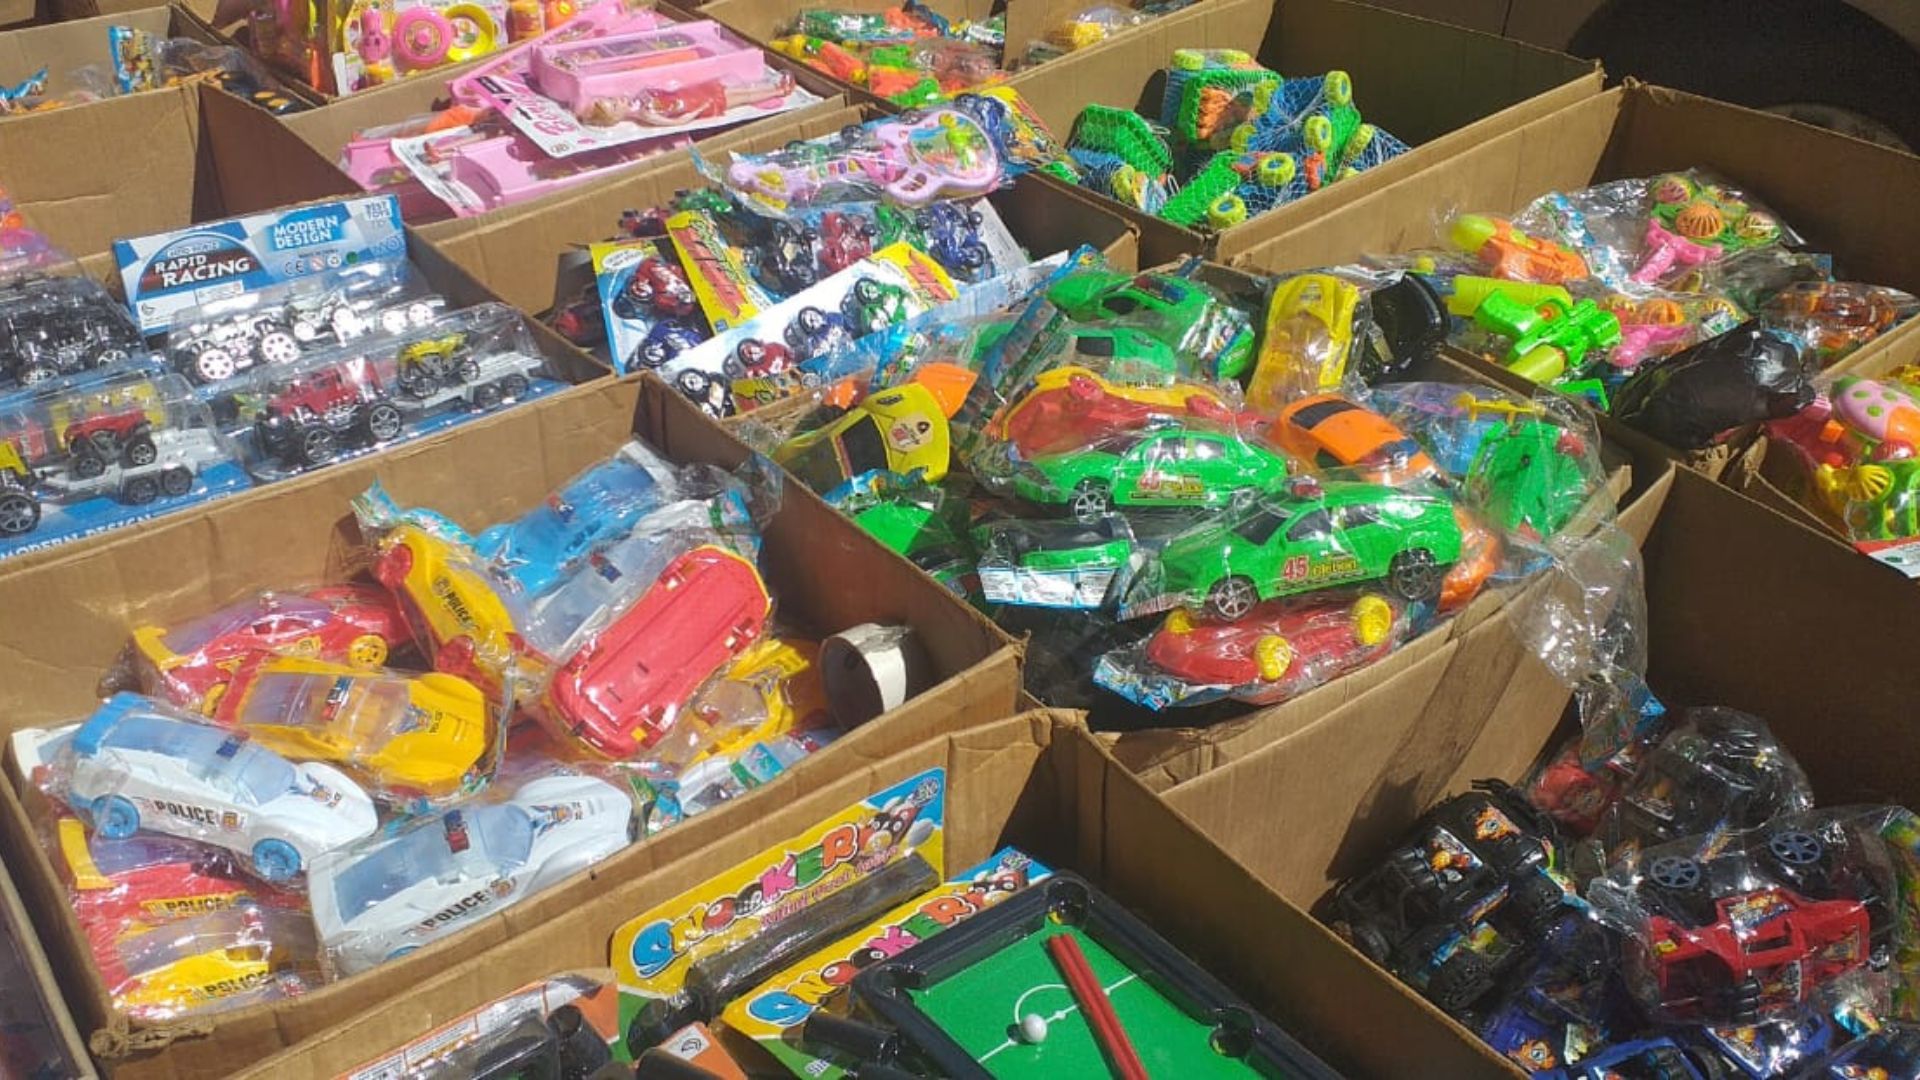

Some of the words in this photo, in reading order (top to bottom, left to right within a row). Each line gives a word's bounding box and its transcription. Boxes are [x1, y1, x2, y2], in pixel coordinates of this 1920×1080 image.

[274, 214, 339, 237] MODERN
[276, 229, 333, 249] DESIGN
[154, 254, 208, 274] RAPID
[162, 257, 251, 288] RACING
[1283, 555, 1310, 580] 45
[153, 799, 217, 826] POLICE
[421, 889, 488, 928] POLICE
